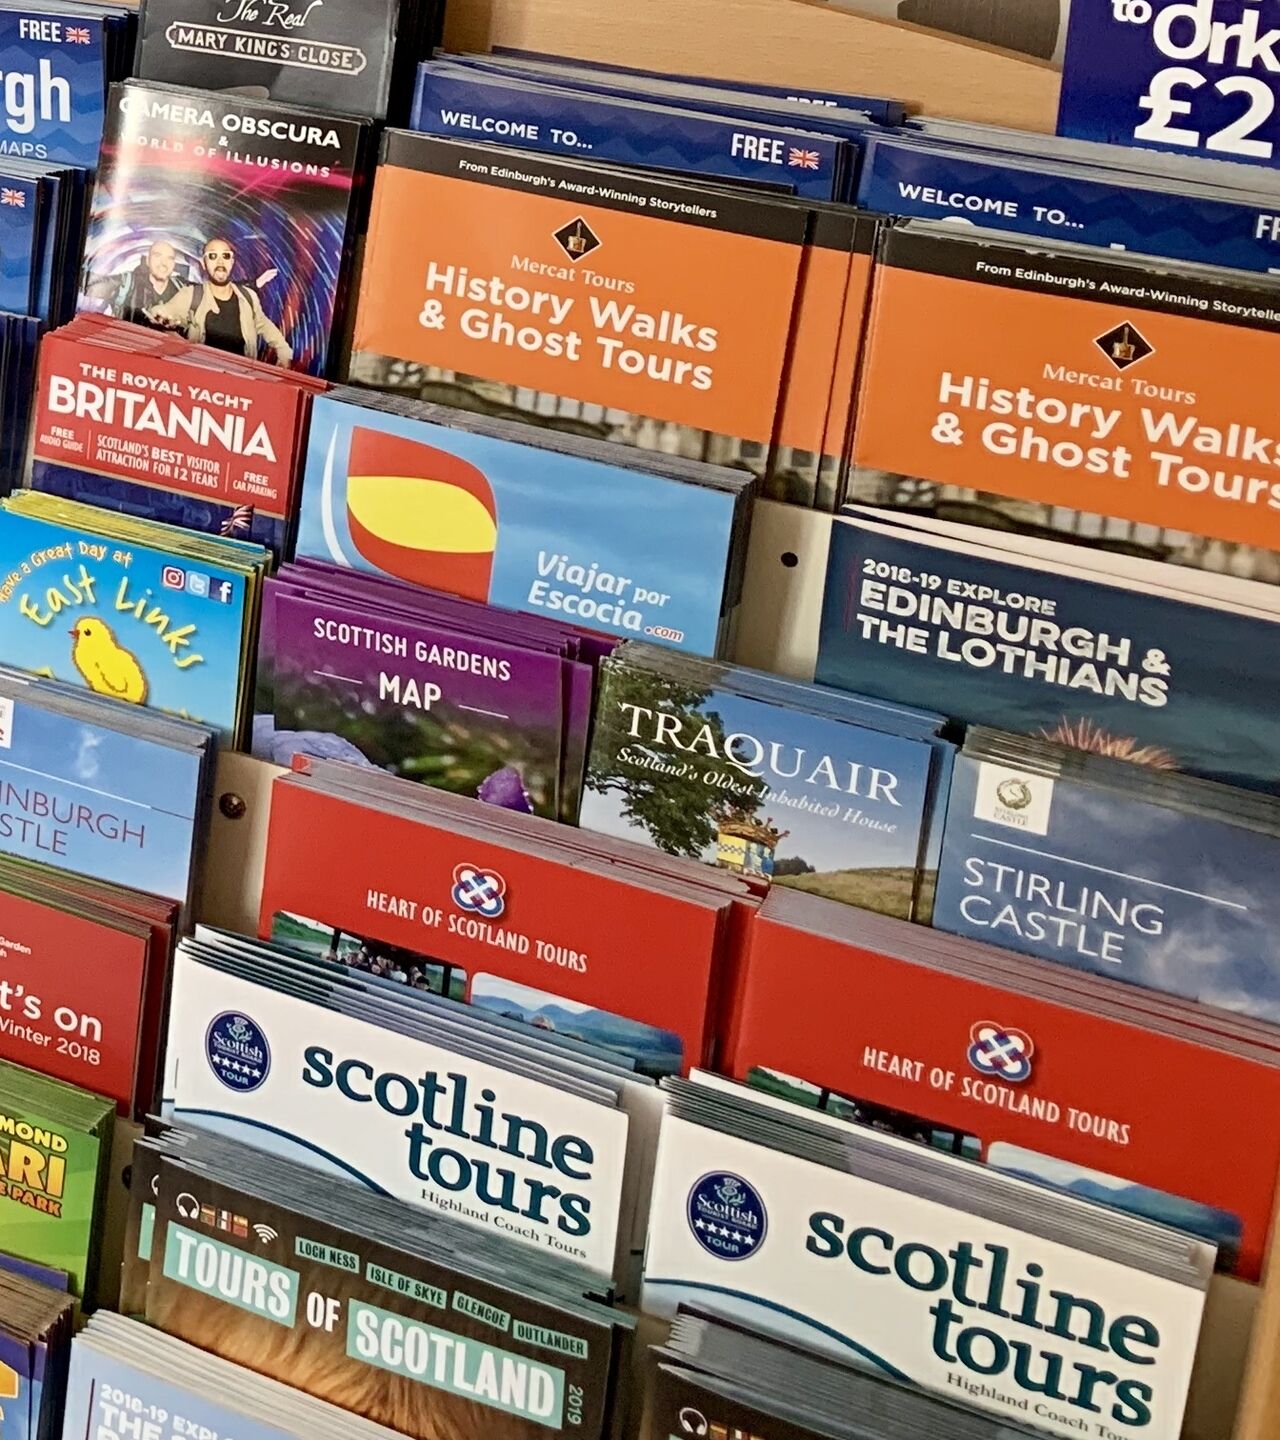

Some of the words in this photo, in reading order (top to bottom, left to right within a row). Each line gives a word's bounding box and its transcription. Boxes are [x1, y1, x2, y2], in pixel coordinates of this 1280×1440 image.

[262, 0, 323, 29] Real
[177, 29, 228, 50] MARY
[235, 37, 290, 59] KING'S
[297, 46, 354, 69] CLOSE
[119, 97, 215, 129] CAMERA
[221, 114, 341, 149] OBSCURA
[459, 160, 490, 176] From
[490, 164, 557, 188] Edinburgh's
[558, 180, 647, 207] Award-Winning
[649, 197, 718, 219] Storytellers
[511, 254, 576, 283] Mercat
[582, 268, 636, 294] Tours
[426, 261, 573, 325] History
[590, 296, 719, 352] Walks
[418, 300, 446, 331] &
[460, 308, 581, 362] Ghost
[597, 337, 714, 391] Tours
[80, 363, 116, 382] THE
[122, 372, 182, 397] ROYAL
[188, 385, 252, 411] YACHT
[1043, 364, 1122, 391] Mercat
[1131, 378, 1197, 405] Tours
[48, 375, 277, 462] BRITANNIA
[537, 550, 631, 599] Viajar
[633, 585, 671, 610] por
[862, 558, 941, 591] 2018-19
[947, 578, 1058, 617] EXPLORE
[19, 564, 96, 625] East
[115, 576, 204, 668] Links
[859, 578, 1132, 667] EDINBURGH
[1141, 648, 1171, 677] &
[313, 617, 407, 658] SCOTTISH
[415, 643, 512, 682] GARDENS
[855, 612, 929, 655] THE
[936, 632, 1169, 709] LOTHIANS
[378, 672, 442, 712] MAP
[617, 701, 903, 807] TRAQUAIR
[617, 744, 699, 781] Scotland's
[703, 771, 754, 797] Oldest
[756, 786, 840, 820] Inhabited
[842, 807, 899, 835] House
[963, 857, 1165, 936] STIRLING
[366, 889, 416, 922] HEART
[422, 907, 443, 928] OF
[448, 913, 530, 955] SCOTLAND
[536, 940, 589, 974] TOURS
[54, 1008, 102, 1042] on
[56, 1039, 101, 1066] 2018
[302, 1045, 594, 1181] scotline
[862, 1045, 925, 1082] HEART
[930, 1066, 955, 1091] OF
[961, 1076, 1061, 1124] SCOTLAND
[1067, 1108, 1131, 1146] TOURS
[11, 1184, 62, 1217] PARK
[405, 1121, 592, 1238] tours
[421, 1187, 490, 1224] Highland
[493, 1213, 540, 1244] Coach
[544, 1235, 588, 1260] Tours
[299, 1239, 327, 1261] LOCH
[329, 1249, 357, 1271] NESS
[370, 1268, 395, 1288] ISLE
[397, 1274, 413, 1293] OF
[414, 1281, 444, 1305] SKYE
[456, 1295, 507, 1328] GLENCOE
[804, 1210, 1162, 1365] scotline
[174, 1231, 291, 1319] TOURS
[306, 1292, 341, 1333] OF
[355, 1308, 557, 1419] SCOTLAND
[516, 1324, 585, 1356] OUTLANDER
[929, 1299, 1153, 1428] tours
[100, 1383, 169, 1424] 2018-19
[567, 1384, 584, 1425] 2019
[946, 1371, 1029, 1413] Highland
[1034, 1402, 1090, 1433] Coach
